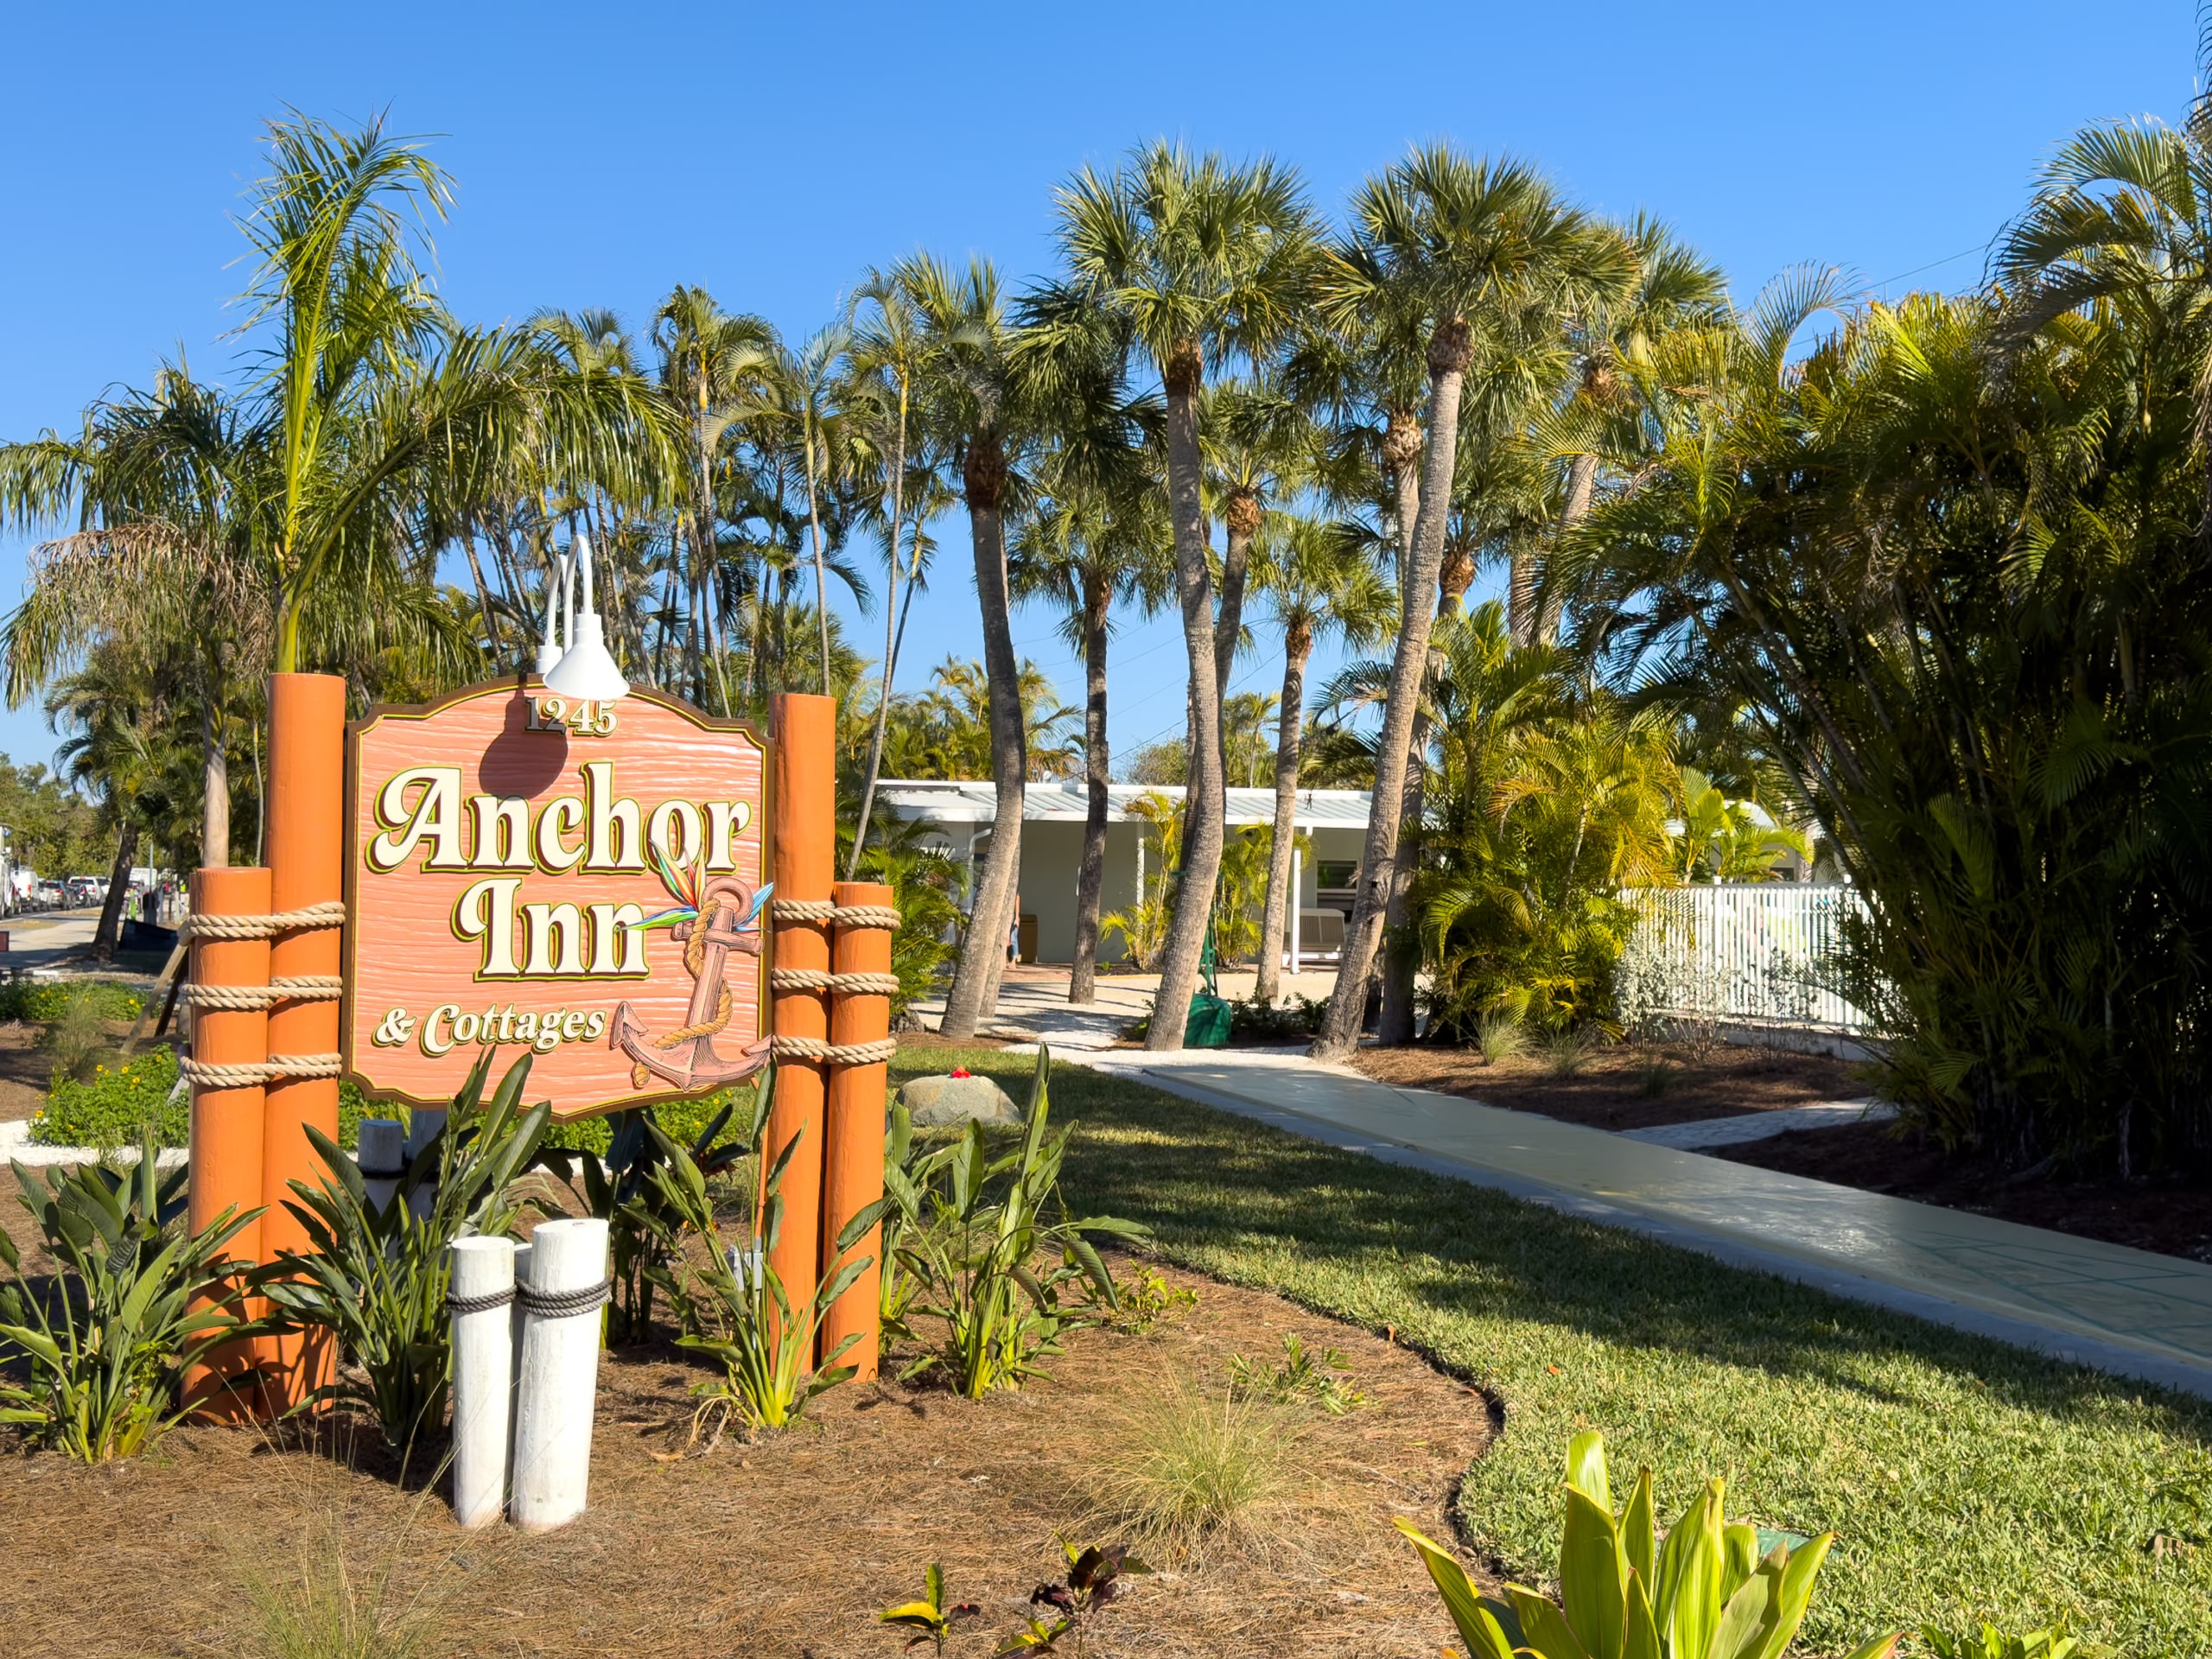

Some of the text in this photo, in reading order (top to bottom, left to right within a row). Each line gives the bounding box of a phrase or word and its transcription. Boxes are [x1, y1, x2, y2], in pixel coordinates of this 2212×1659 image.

[524, 697, 618, 735] 1245
[365, 762, 751, 875] Anchor
[451, 878, 650, 982] Inn
[372, 1004, 607, 1056] & Cottages
